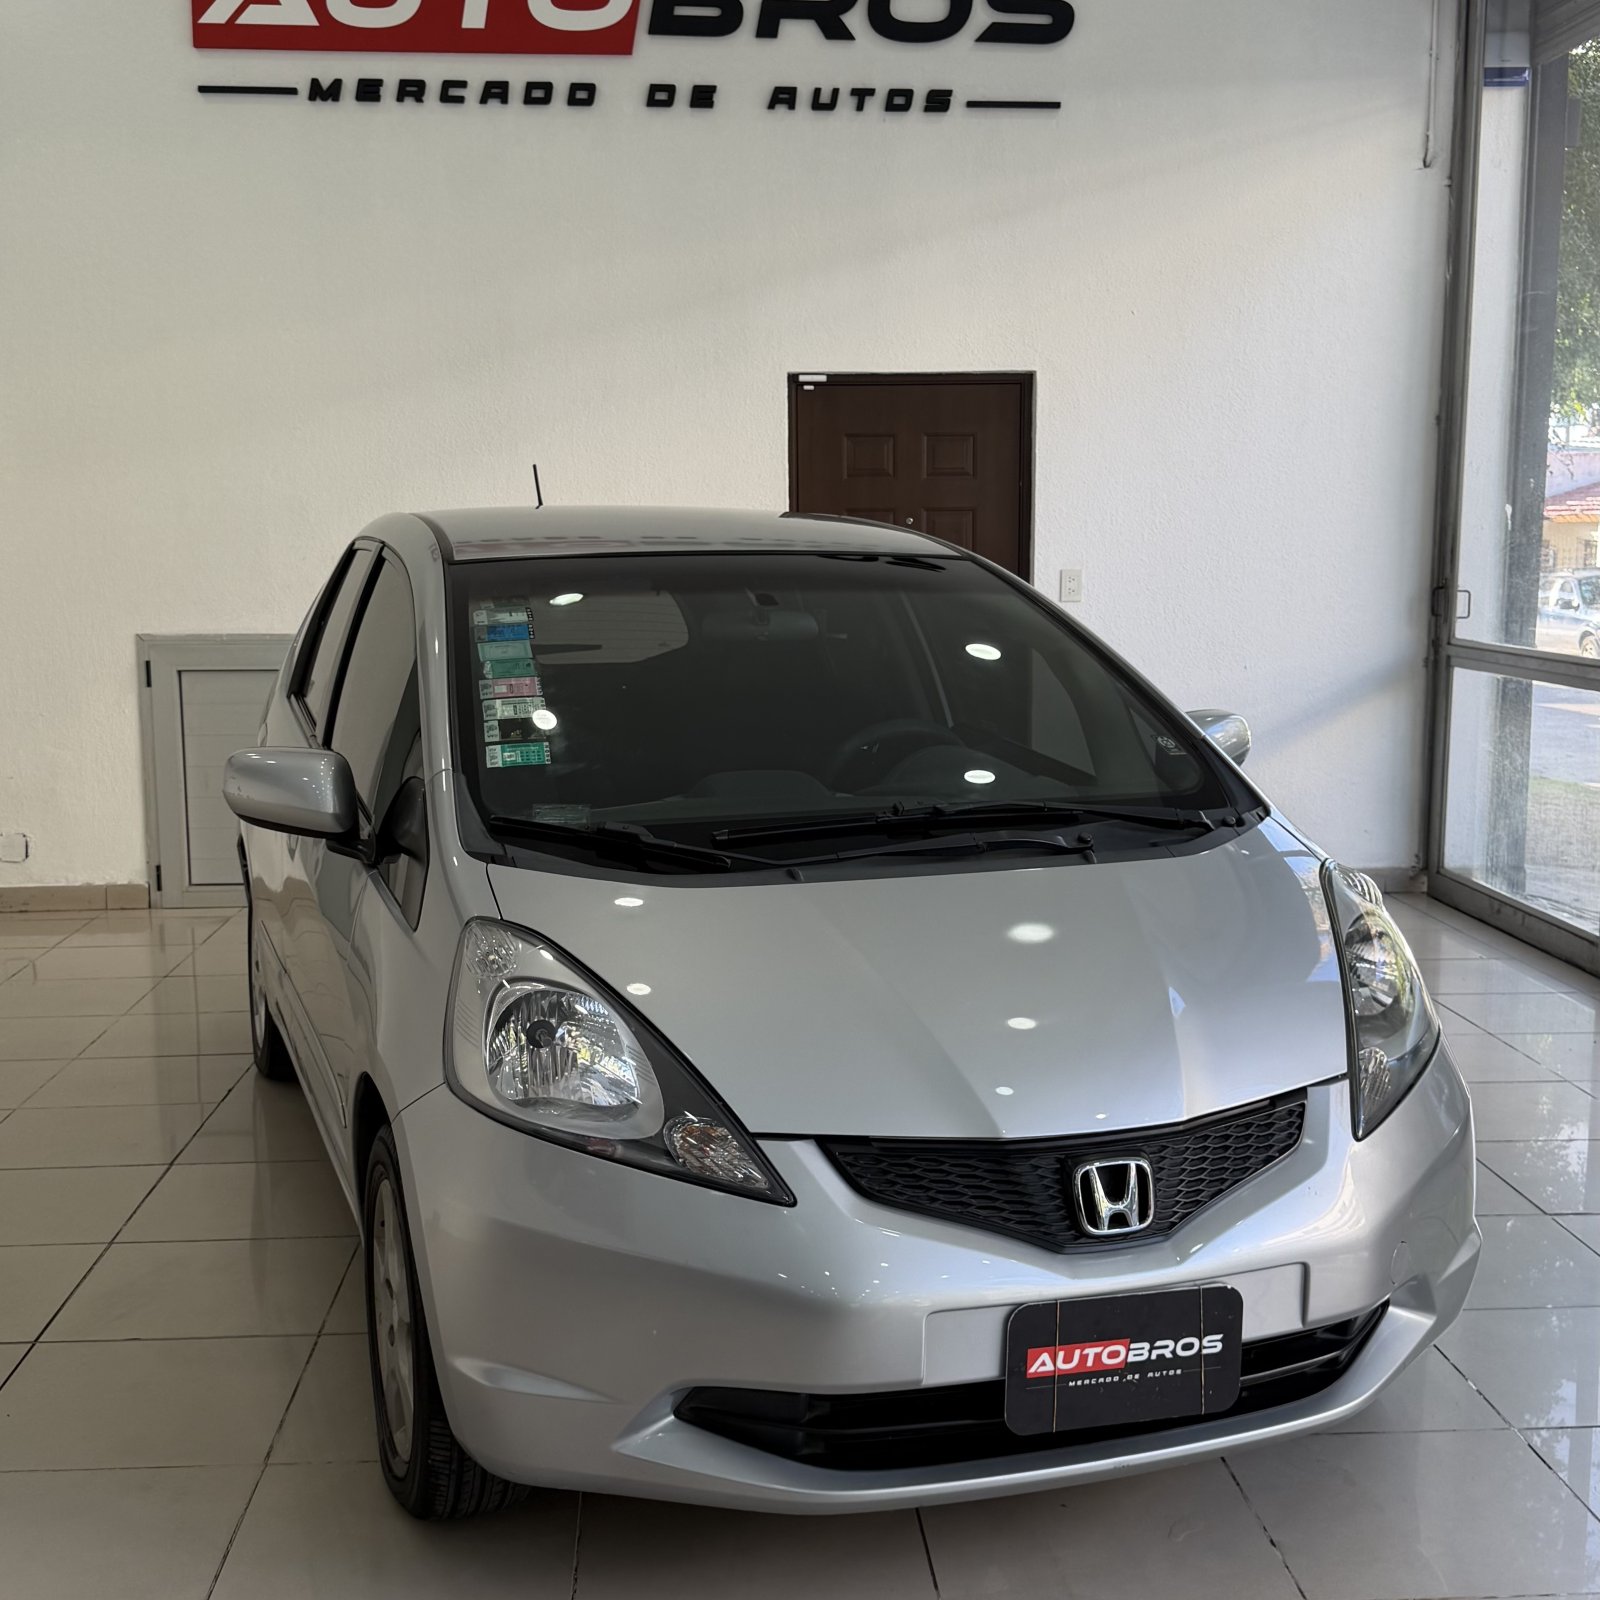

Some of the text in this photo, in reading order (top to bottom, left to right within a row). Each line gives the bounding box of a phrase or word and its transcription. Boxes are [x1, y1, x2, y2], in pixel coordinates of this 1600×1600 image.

[308, 77, 953, 113] MERCADO DE AUTOS
[1028, 1333, 1224, 1374] AUTOBROS
[1068, 1369, 1182, 1387] MERCADO DE AUTOS
